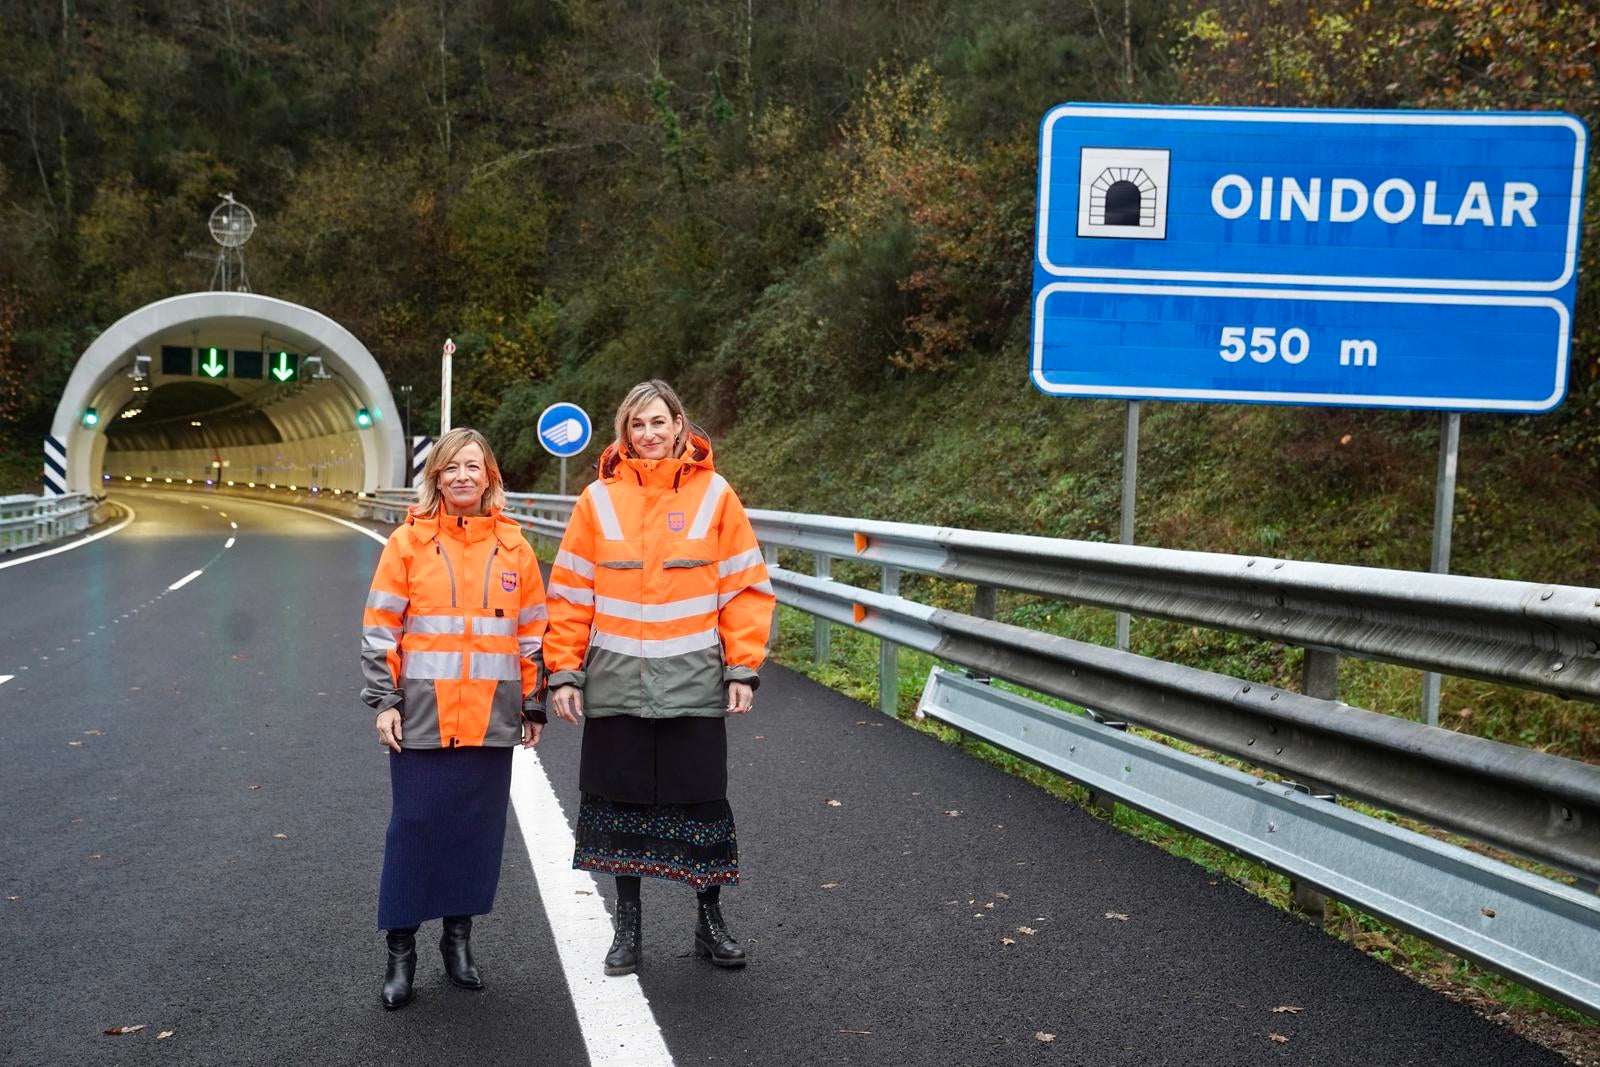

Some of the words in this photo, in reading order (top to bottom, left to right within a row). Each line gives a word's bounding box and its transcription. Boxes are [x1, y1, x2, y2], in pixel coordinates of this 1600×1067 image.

[1211, 174, 1538, 227] OINDOLAR
[1219, 327, 1310, 365] 550
[1339, 339, 1378, 367] m
